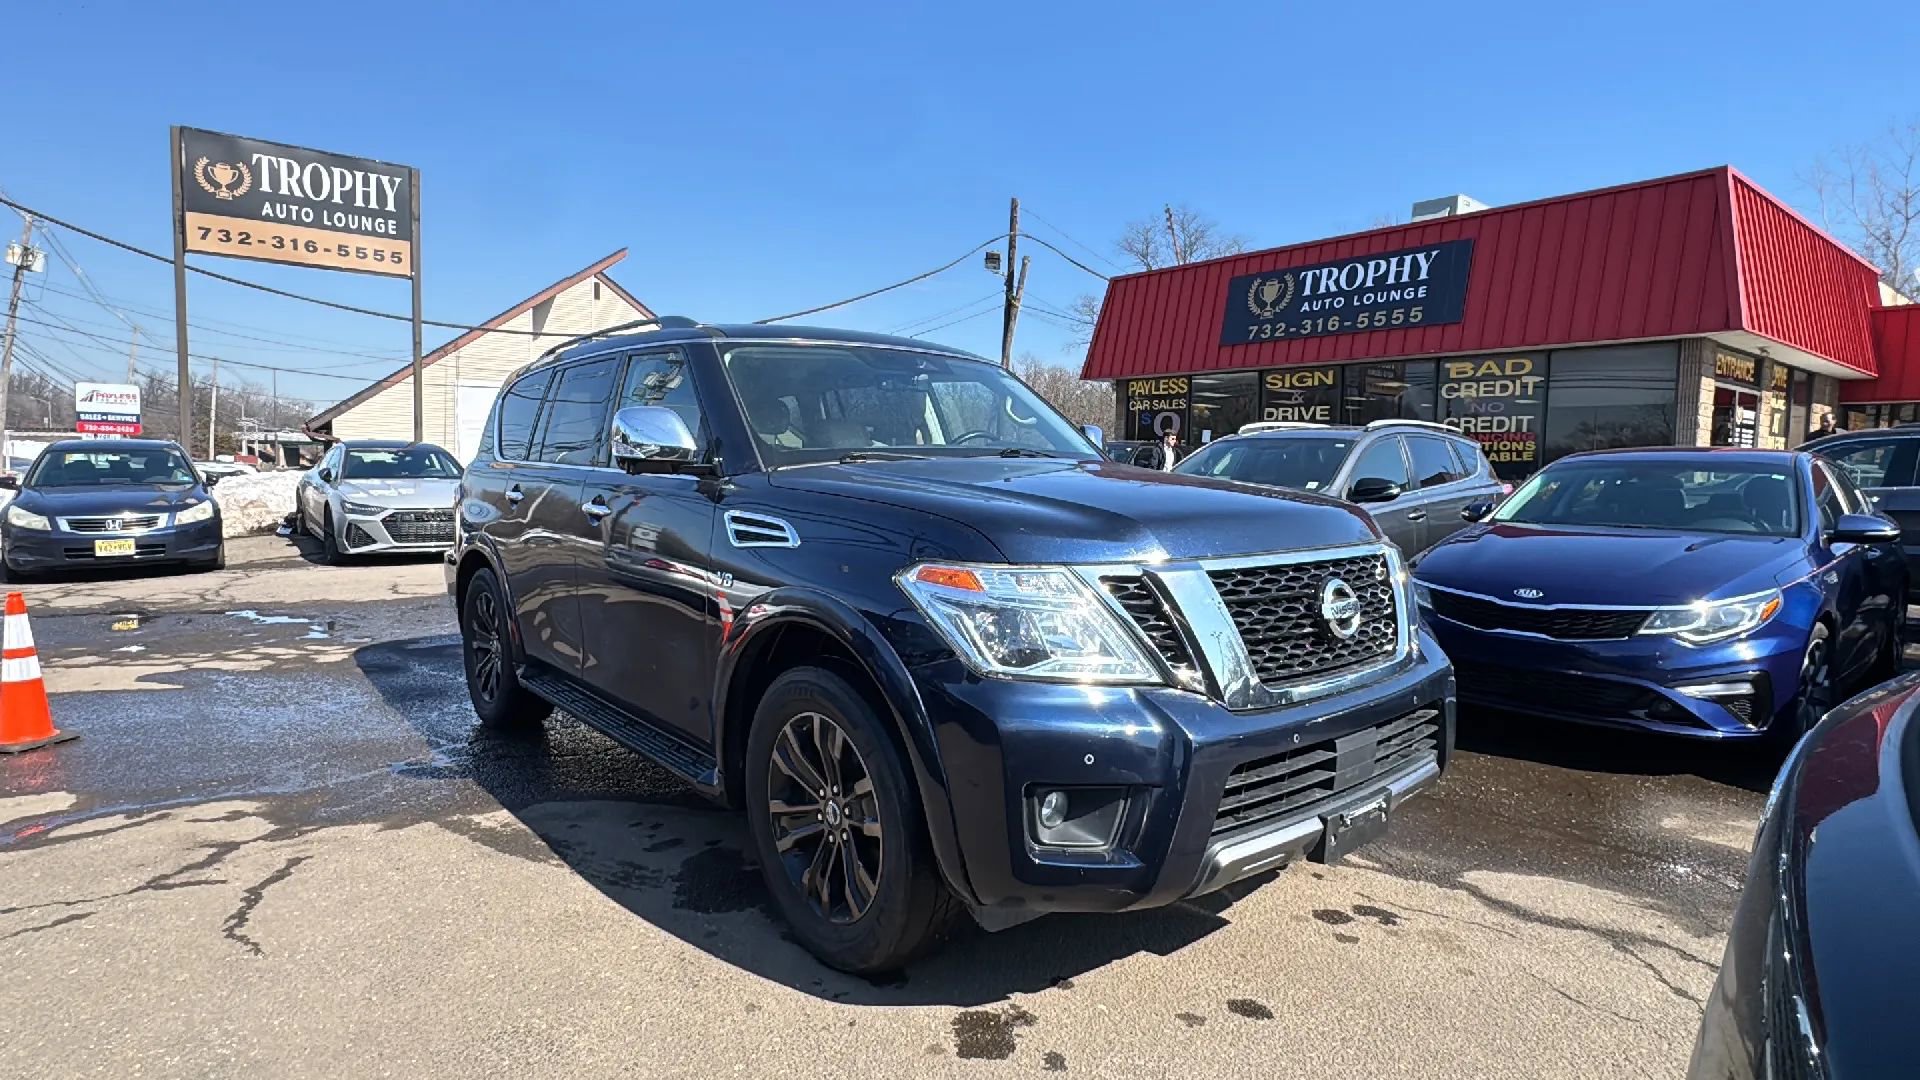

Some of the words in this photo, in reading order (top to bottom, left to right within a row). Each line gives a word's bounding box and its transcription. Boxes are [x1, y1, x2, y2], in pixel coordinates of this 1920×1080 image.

[252, 153, 402, 212] TROPHY
[262, 202, 314, 223] AUTO
[323, 210, 397, 235] LOUNGE
[197, 226, 403, 265] 732-316-5555
[1300, 250, 1440, 297] TROPHY
[1300, 297, 1345, 313] AUTO
[1353, 286, 1428, 306] LOUNGE
[1248, 306, 1424, 340] 732-316-5555
[1449, 359, 1533, 379] BAD
[1128, 377, 1188, 397] PAYLESS
[1265, 370, 1334, 390] SIGN
[1441, 376, 1537, 399] CREDIT
[1129, 400, 1150, 411] CAR
[1152, 398, 1187, 410] SALES
[1291, 390, 1304, 403] &
[1263, 405, 1331, 421] DRIVE
[1471, 402, 1505, 413] NO
[1443, 416, 1535, 433] CREDIT
[1481, 441, 1537, 451] TIONS
[1487, 452, 1534, 462] ABLE
[717, 571, 733, 587] V8
